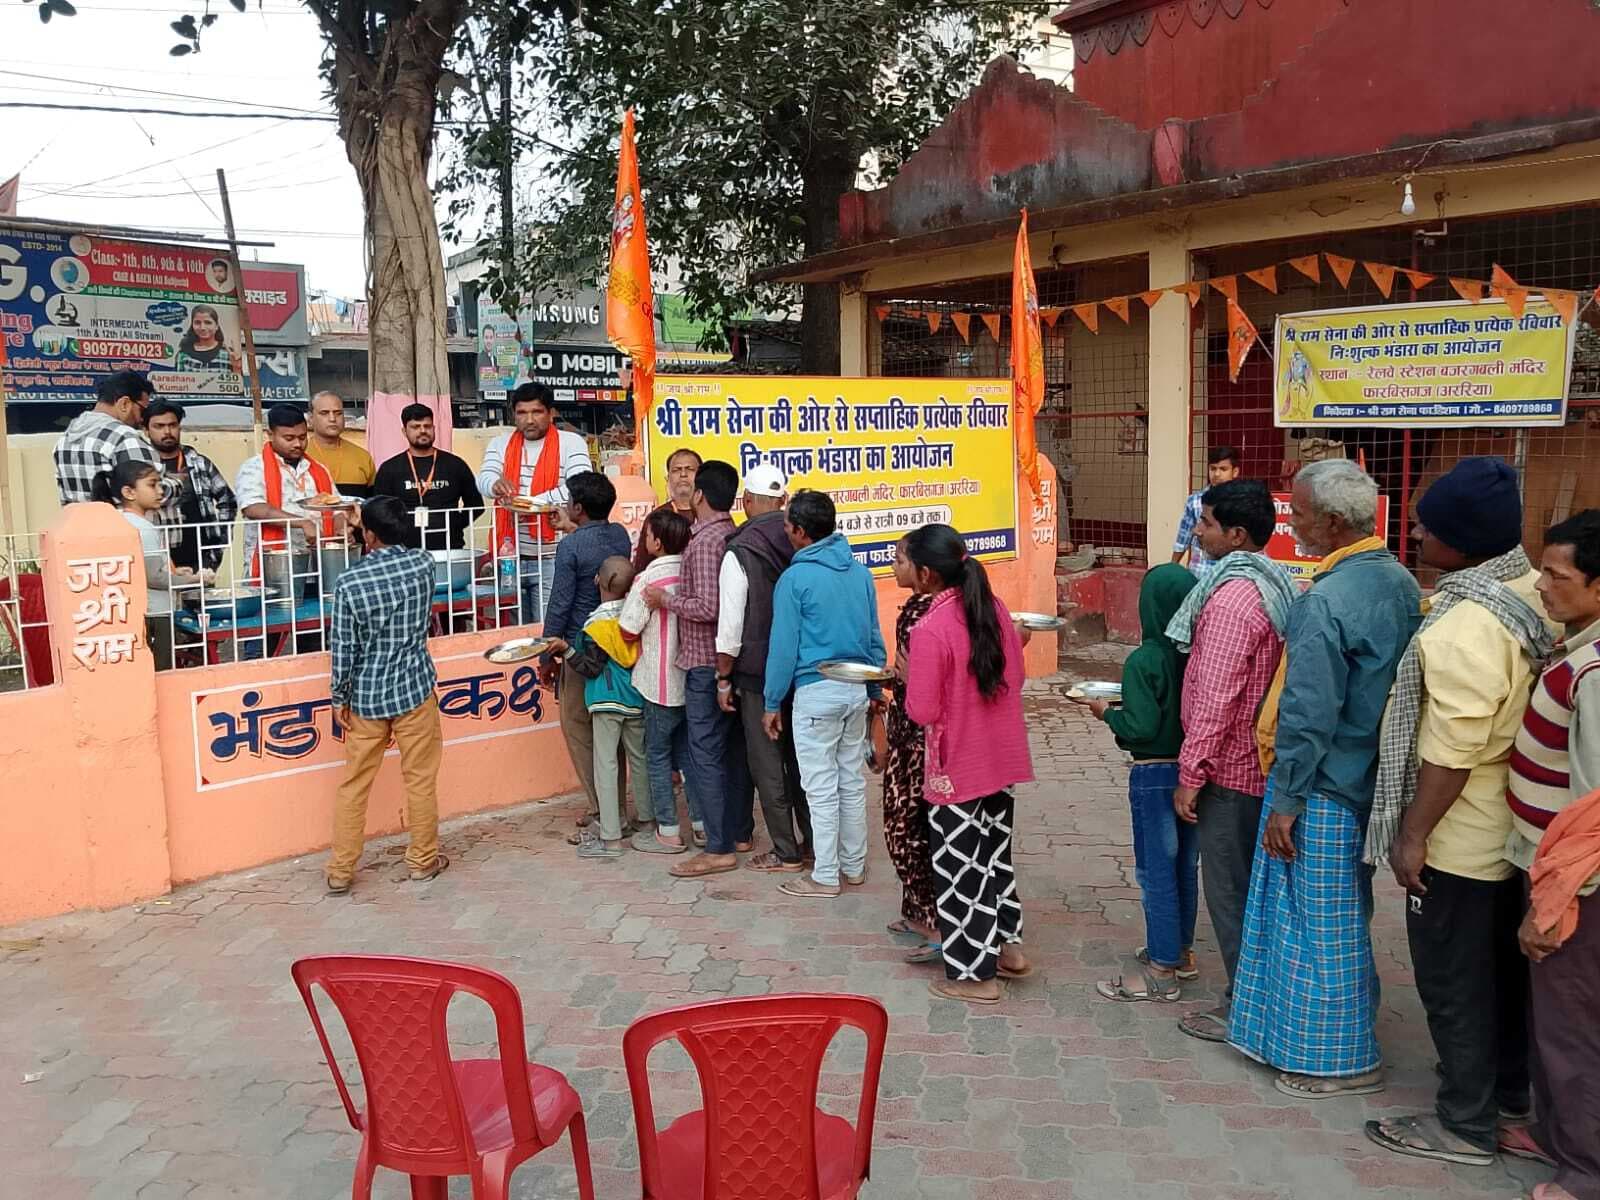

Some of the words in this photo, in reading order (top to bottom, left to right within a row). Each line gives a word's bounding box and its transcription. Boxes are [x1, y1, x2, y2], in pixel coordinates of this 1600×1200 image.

[177, 258, 185, 271] &
[91, 319, 149, 329] INTERMEDIATE
[1300, 330, 1320, 342] राम
[1325, 326, 1347, 341] सेना
[1352, 324, 1366, 339] की
[1372, 322, 1394, 339] ओर
[1399, 321, 1409, 337] से
[1474, 316, 1513, 333] प्रत्येक
[1519, 313, 1562, 330] रविवार
[83, 341, 162, 357] 9097794023
[1384, 341, 1417, 357] भंडारा
[1422, 343, 1438, 355] का
[1443, 337, 1502, 355] आयोजन
[151, 374, 196, 383] Aaradhana
[217, 374, 239, 382] 450
[1319, 369, 1347, 380] स्थान
[1367, 366, 1394, 379] रेलवे
[1400, 364, 1436, 378] स्टेशन
[218, 384, 240, 393] 500
[656, 398, 681, 435] श्री
[687, 407, 721, 435] राम
[726, 397, 764, 433] सेना
[768, 398, 792, 432] की
[798, 397, 830, 431] ओर
[835, 397, 849, 431] से
[922, 397, 963, 429] प्रत्येक
[966, 397, 1008, 427] रविवार
[818, 439, 862, 473] भंडारा
[865, 446, 886, 470] का
[891, 437, 953, 469] आयोजन
[847, 514, 861, 530] बजे
[863, 513, 872, 528] से
[875, 511, 894, 528] रात्री
[897, 513, 908, 526] 09
[911, 510, 924, 524] बजे
[926, 510, 941, 524] तक
[66, 555, 134, 593] जय
[72, 586, 131, 635] श्री
[72, 633, 138, 672] राम
